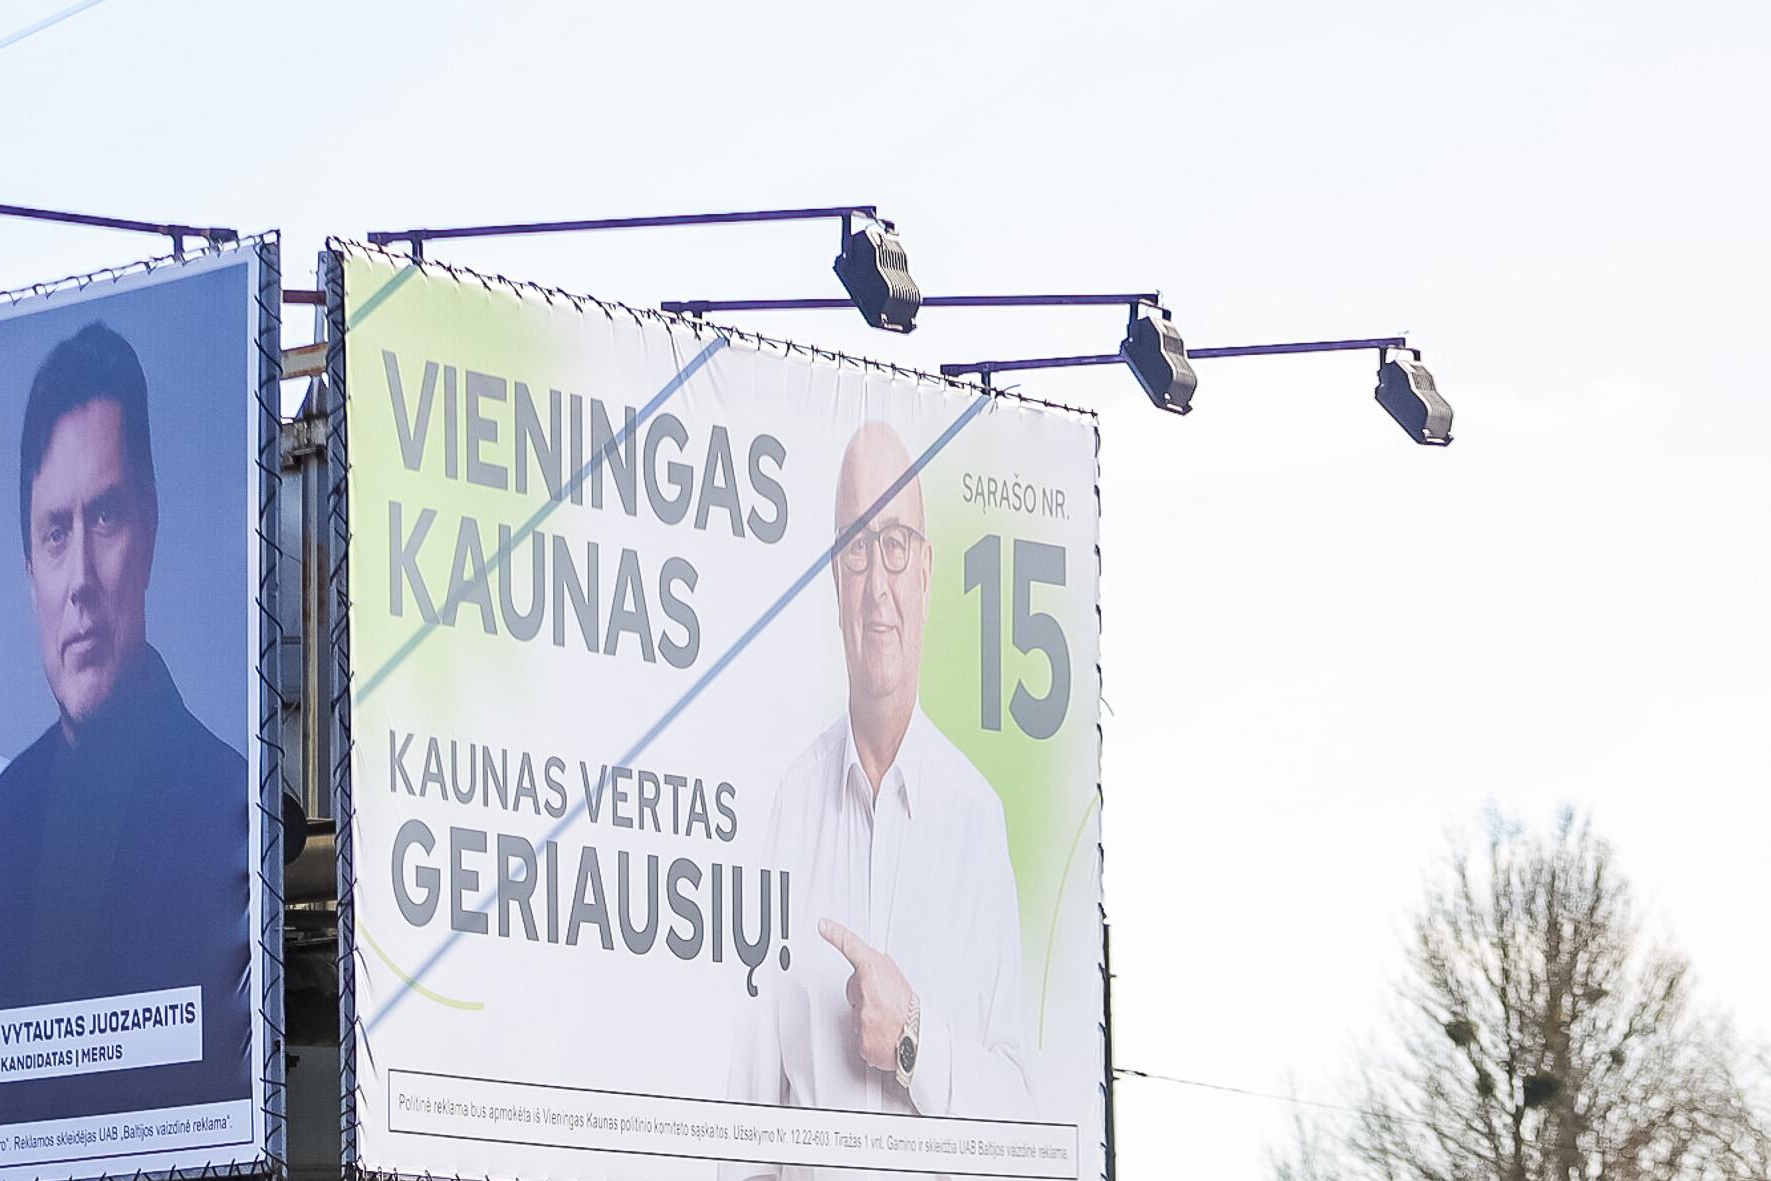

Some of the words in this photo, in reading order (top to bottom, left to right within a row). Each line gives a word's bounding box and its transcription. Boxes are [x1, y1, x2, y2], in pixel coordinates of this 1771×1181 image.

[381, 349, 788, 544] VIENINGAS
[963, 472, 1036, 514] SĄRAŠO
[1042, 488, 1070, 520] NR.
[388, 501, 700, 669] KAUNAS
[964, 534, 1071, 739] 15
[390, 729, 567, 818] KAUNAS
[580, 761, 737, 842] VERTAS
[391, 819, 790, 997] GERIAUSIŲ!
[0, 1050, 72, 1072] KANDIDATAS
[82, 1044, 123, 1064] MERUS
[1, 1014, 85, 1045] VYTAUTAS
[89, 1001, 196, 1034] JUOZAPAITIS
[14, 1132, 54, 1151] Reklamos
[99, 1125, 118, 1142] UAB
[433, 1098, 469, 1118] reklama
[470, 1101, 487, 1119] bus
[542, 1108, 585, 1131] Vieningas
[586, 1112, 619, 1130] Kaunas
